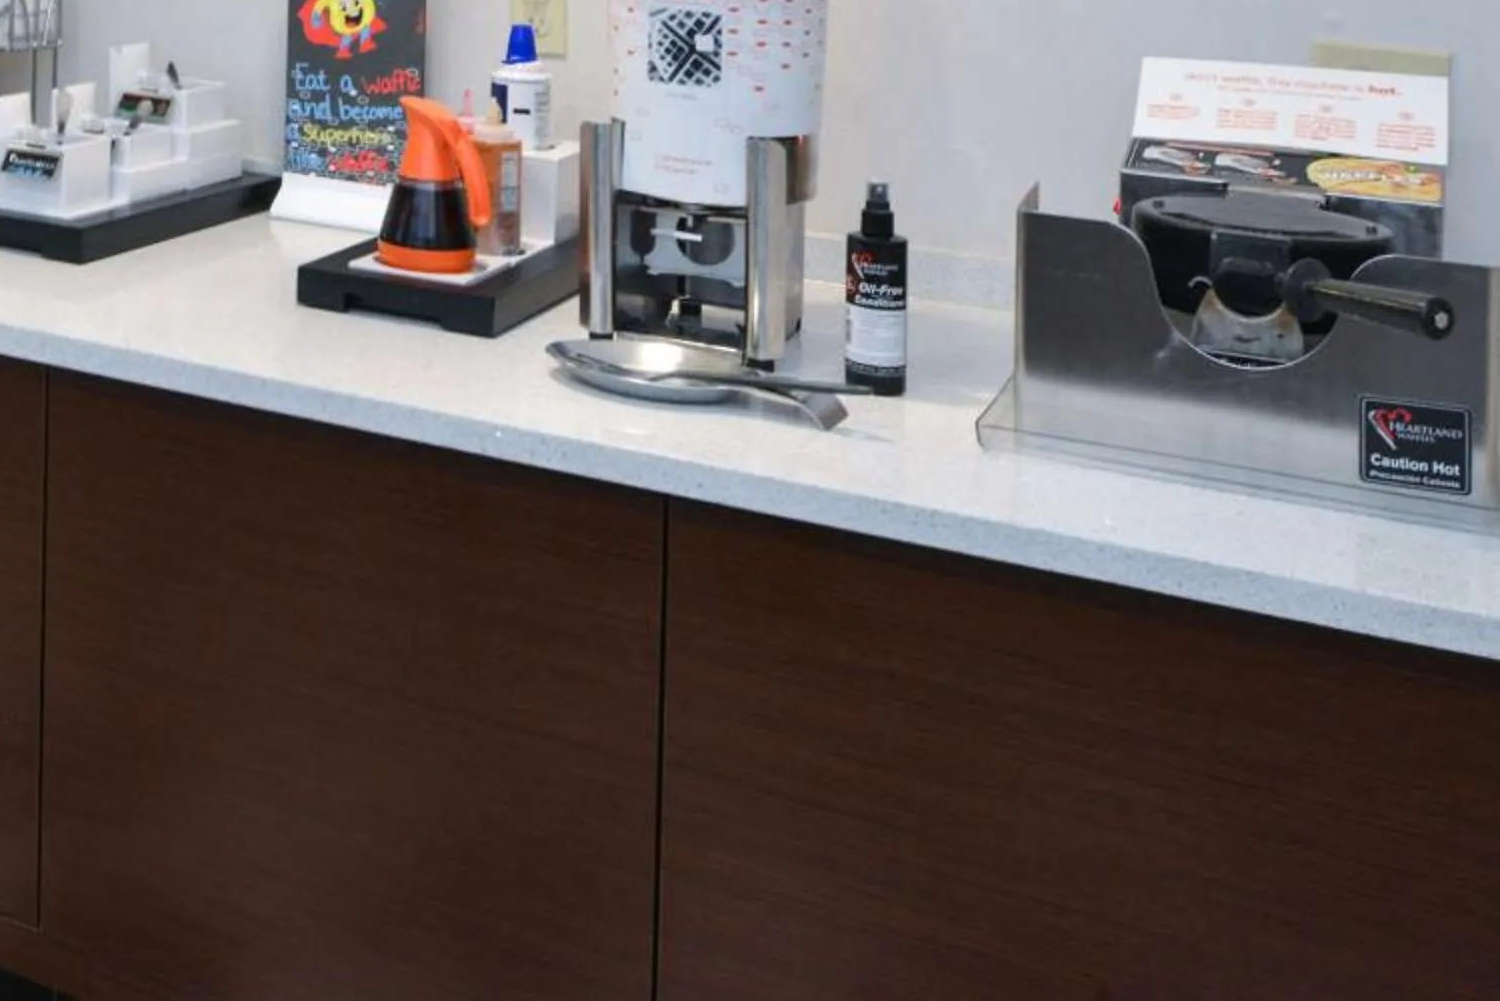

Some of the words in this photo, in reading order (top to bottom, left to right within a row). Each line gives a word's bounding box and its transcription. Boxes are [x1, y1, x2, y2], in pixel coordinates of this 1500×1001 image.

[294, 63, 330, 90] Eat
[338, 97, 404, 120] become
[1370, 452, 1429, 473] Caution
[1432, 461, 1461, 477] Hot
